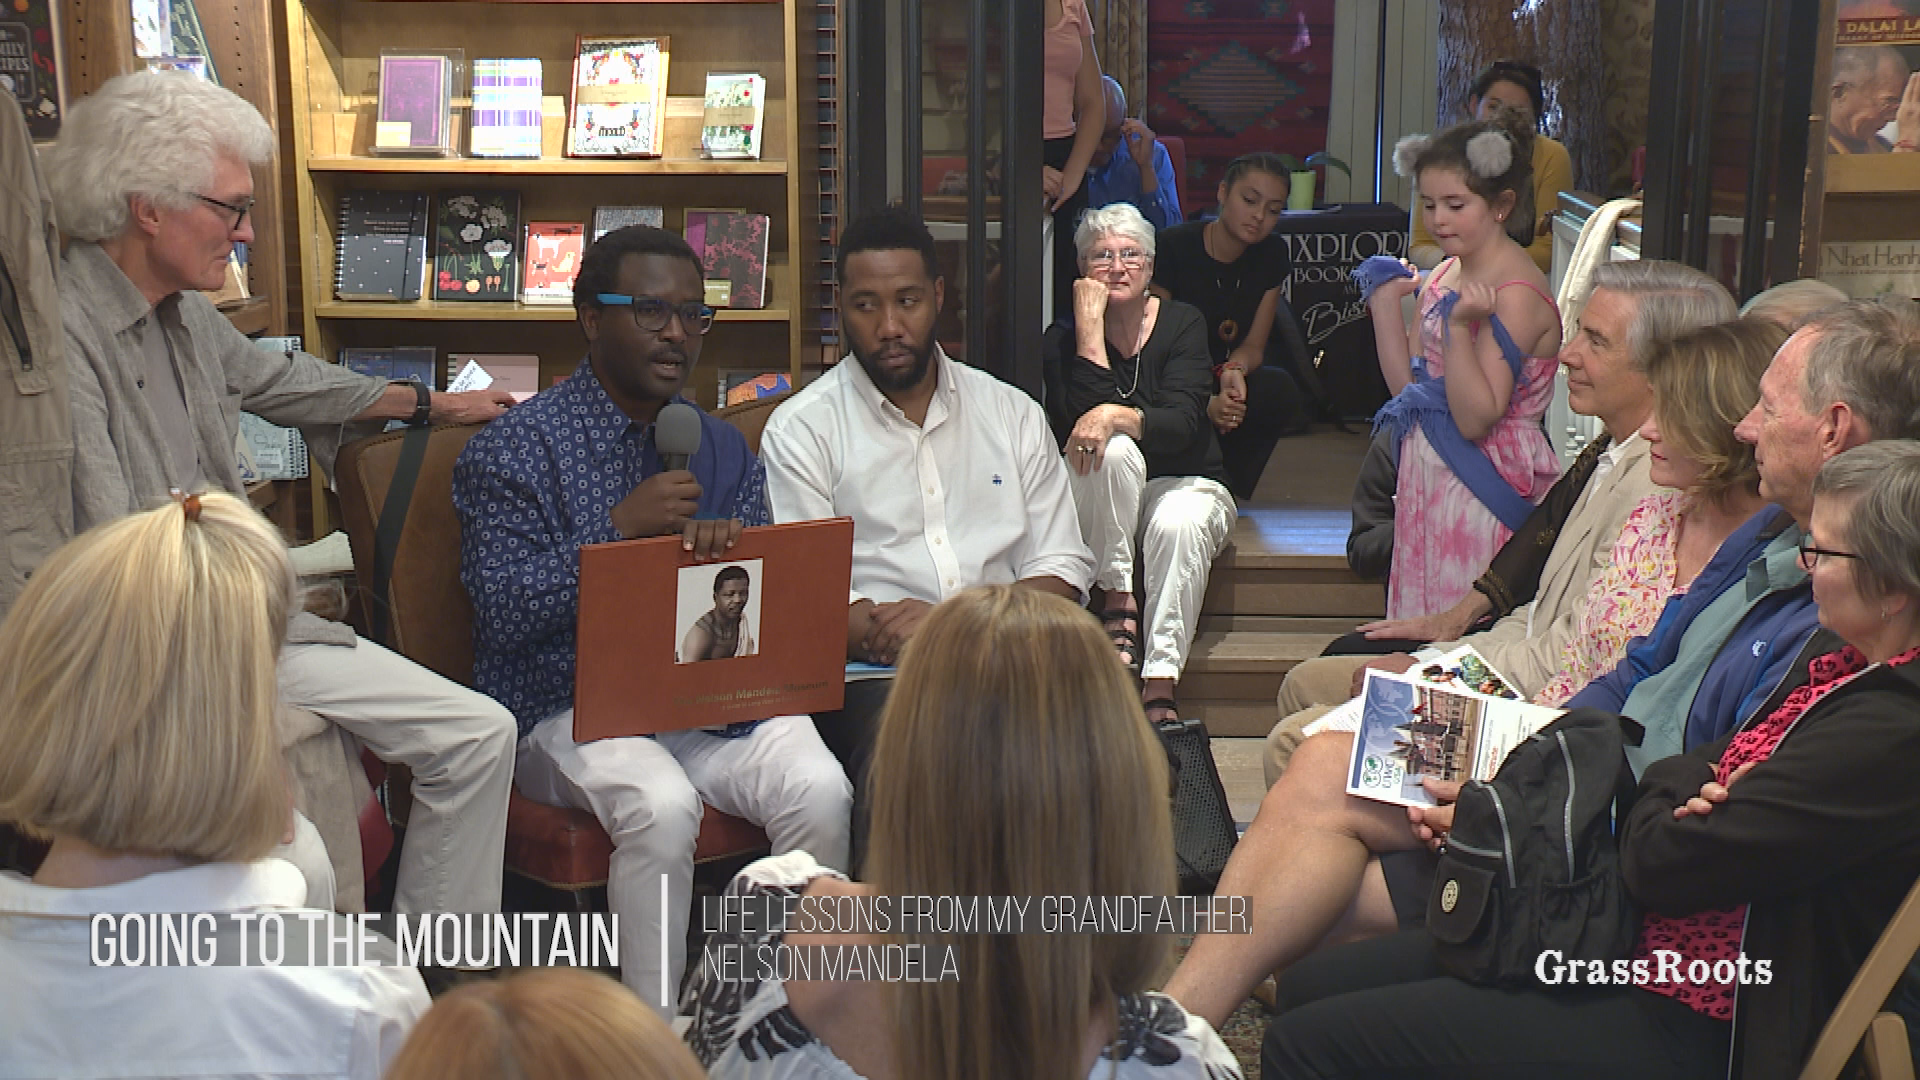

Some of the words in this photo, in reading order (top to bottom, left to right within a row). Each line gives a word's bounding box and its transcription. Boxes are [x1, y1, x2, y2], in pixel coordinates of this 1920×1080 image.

[1846, 21, 1897, 33] DALAI
[1294, 267, 1352, 284] BOOK
[736, 686, 780, 699] Mandela
